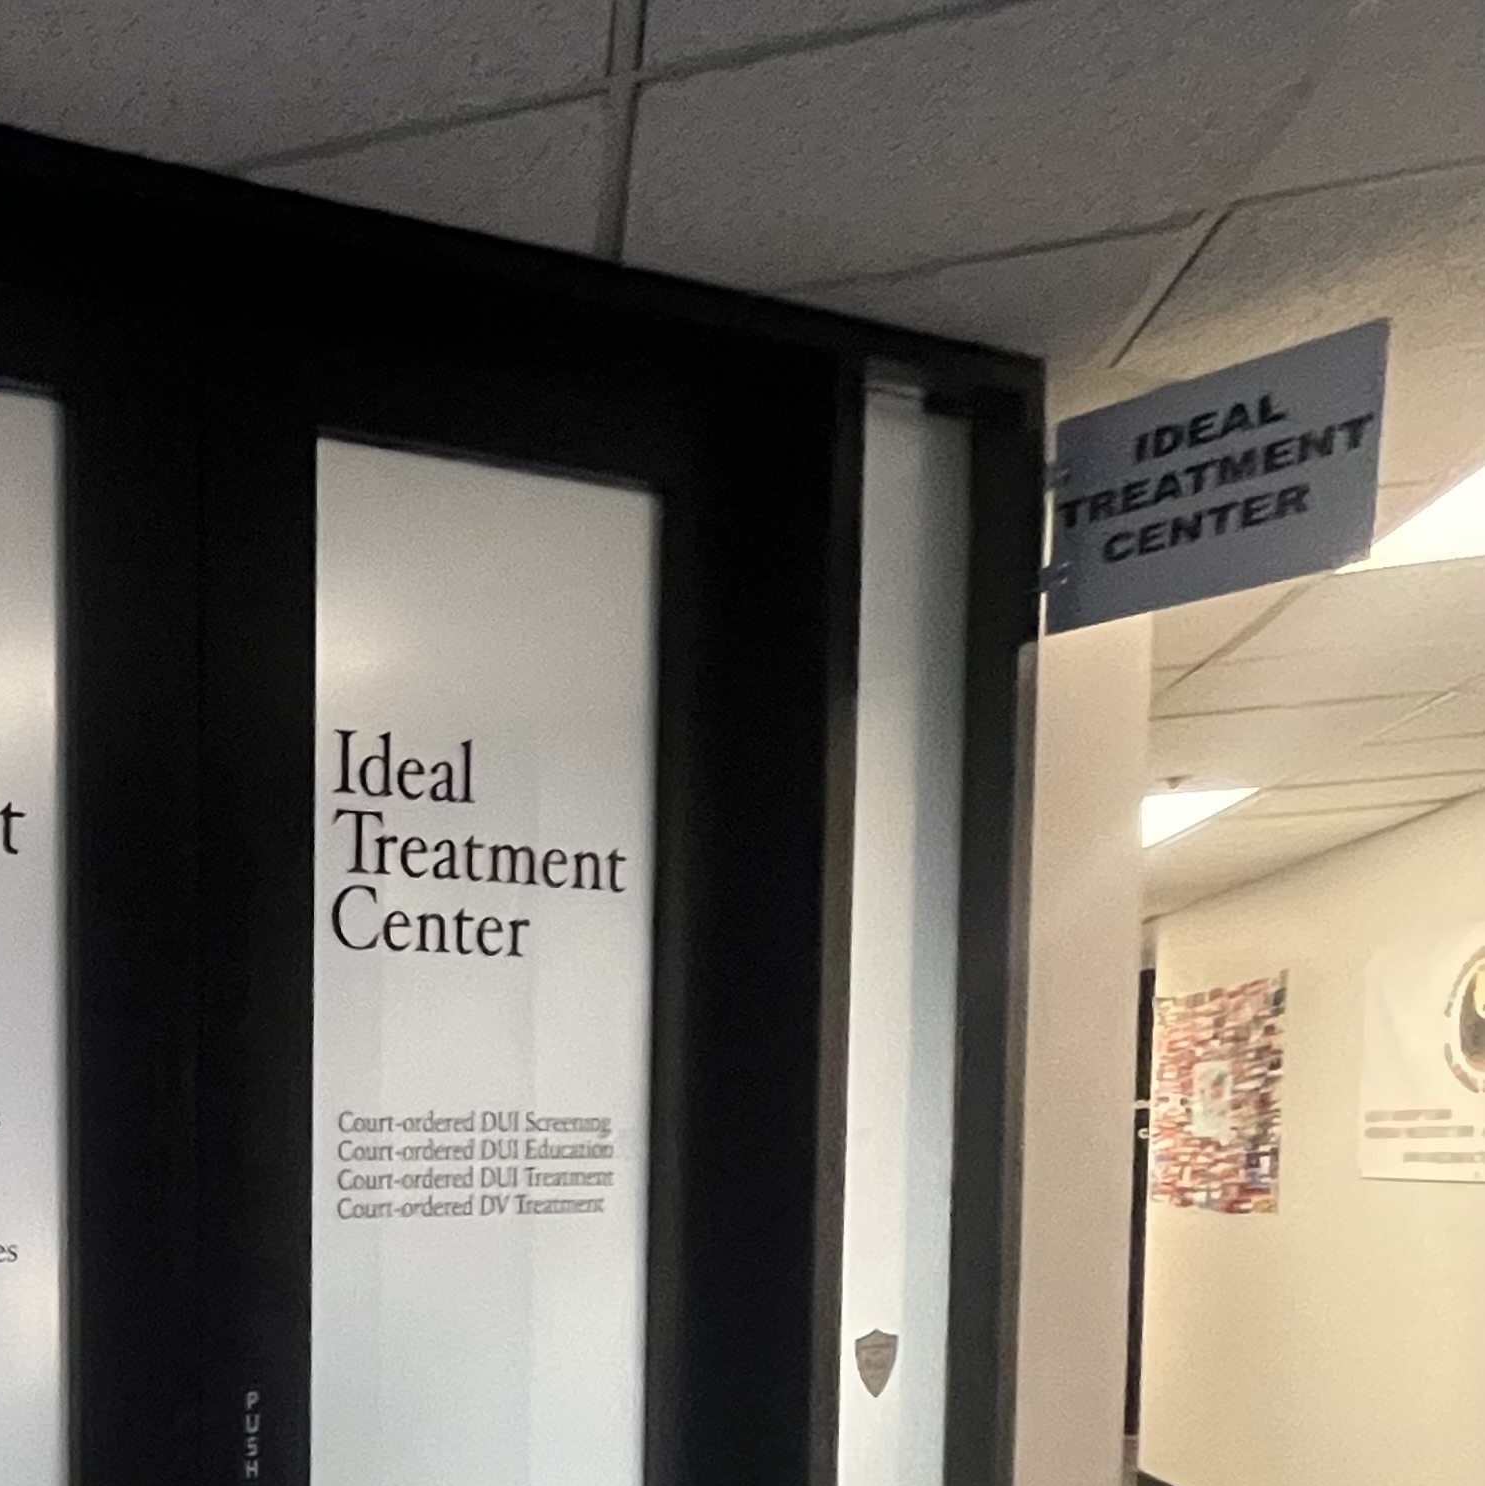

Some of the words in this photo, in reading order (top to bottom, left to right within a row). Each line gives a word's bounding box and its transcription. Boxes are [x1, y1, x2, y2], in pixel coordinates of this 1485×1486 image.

[1132, 391, 1287, 465] IDEAL
[1055, 412, 1374, 529] TREATMENT
[1101, 482, 1311, 564] CENTER
[332, 728, 476, 804] Ideal
[331, 808, 628, 894] Treatment
[331, 884, 531, 958] Center
[337, 1138, 474, 1161] Court-ordered
[480, 1139, 518, 1160] DUI
[524, 1137, 614, 1160] Education
[338, 1110, 474, 1133] Court-ordered
[480, 1111, 519, 1132] DUI
[336, 1195, 473, 1219] Court-ordered
[480, 1194, 510, 1216] DV
[337, 1166, 473, 1190] Court-ordered
[480, 1167, 518, 1188] DUI
[524, 1166, 614, 1188] Treatment
[245, 1391, 260, 1479] PUSH
